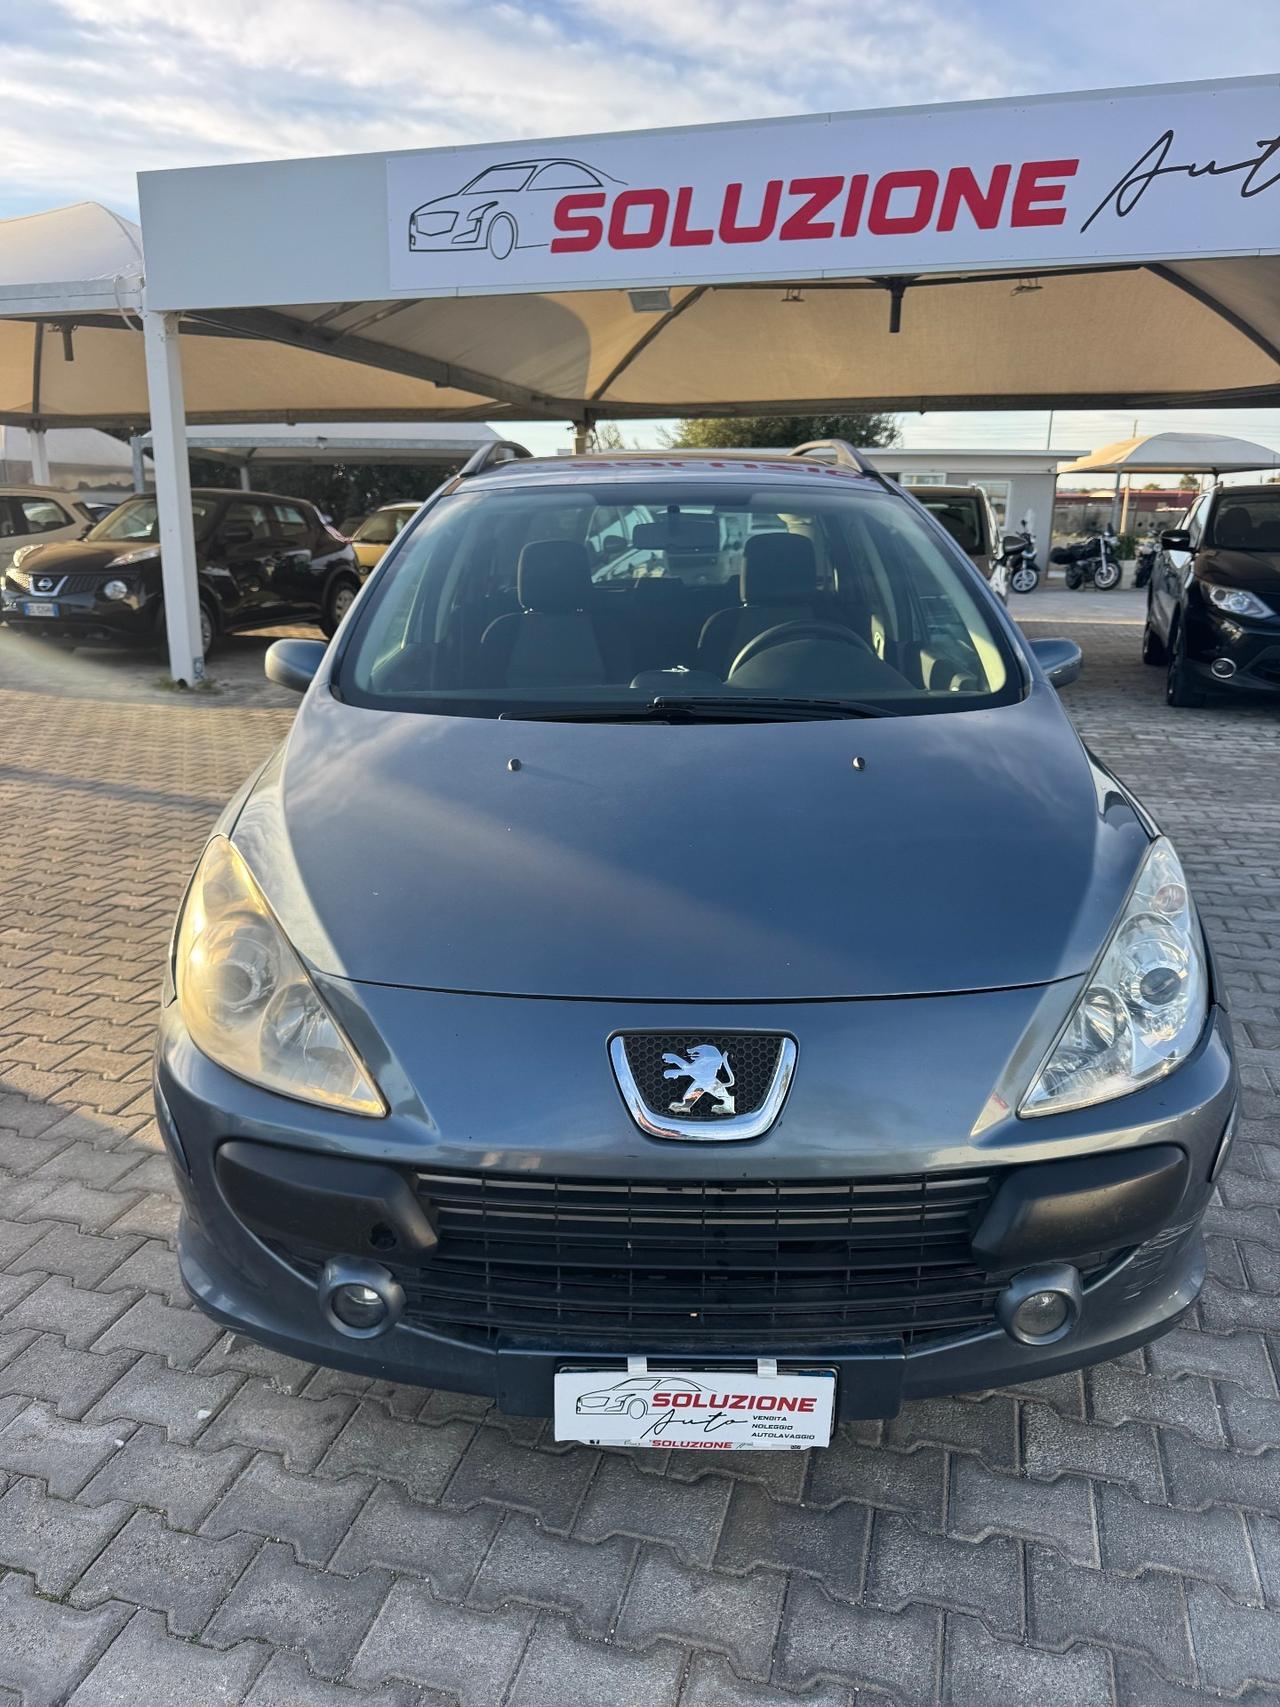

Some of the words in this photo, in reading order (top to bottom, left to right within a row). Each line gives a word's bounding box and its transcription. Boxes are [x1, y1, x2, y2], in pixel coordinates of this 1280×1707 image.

[551, 159, 1079, 253] SOLUZIONE
[652, 1392, 817, 1413] SOLUZIONE
[752, 1414, 787, 1422] VENDITA
[640, 1408, 748, 1439] Auto
[751, 1423, 794, 1431] NOLEGGIO
[751, 1431, 816, 1441] AUTOLAVAGGIO
[651, 1440, 734, 1449] SOLUZIONE
